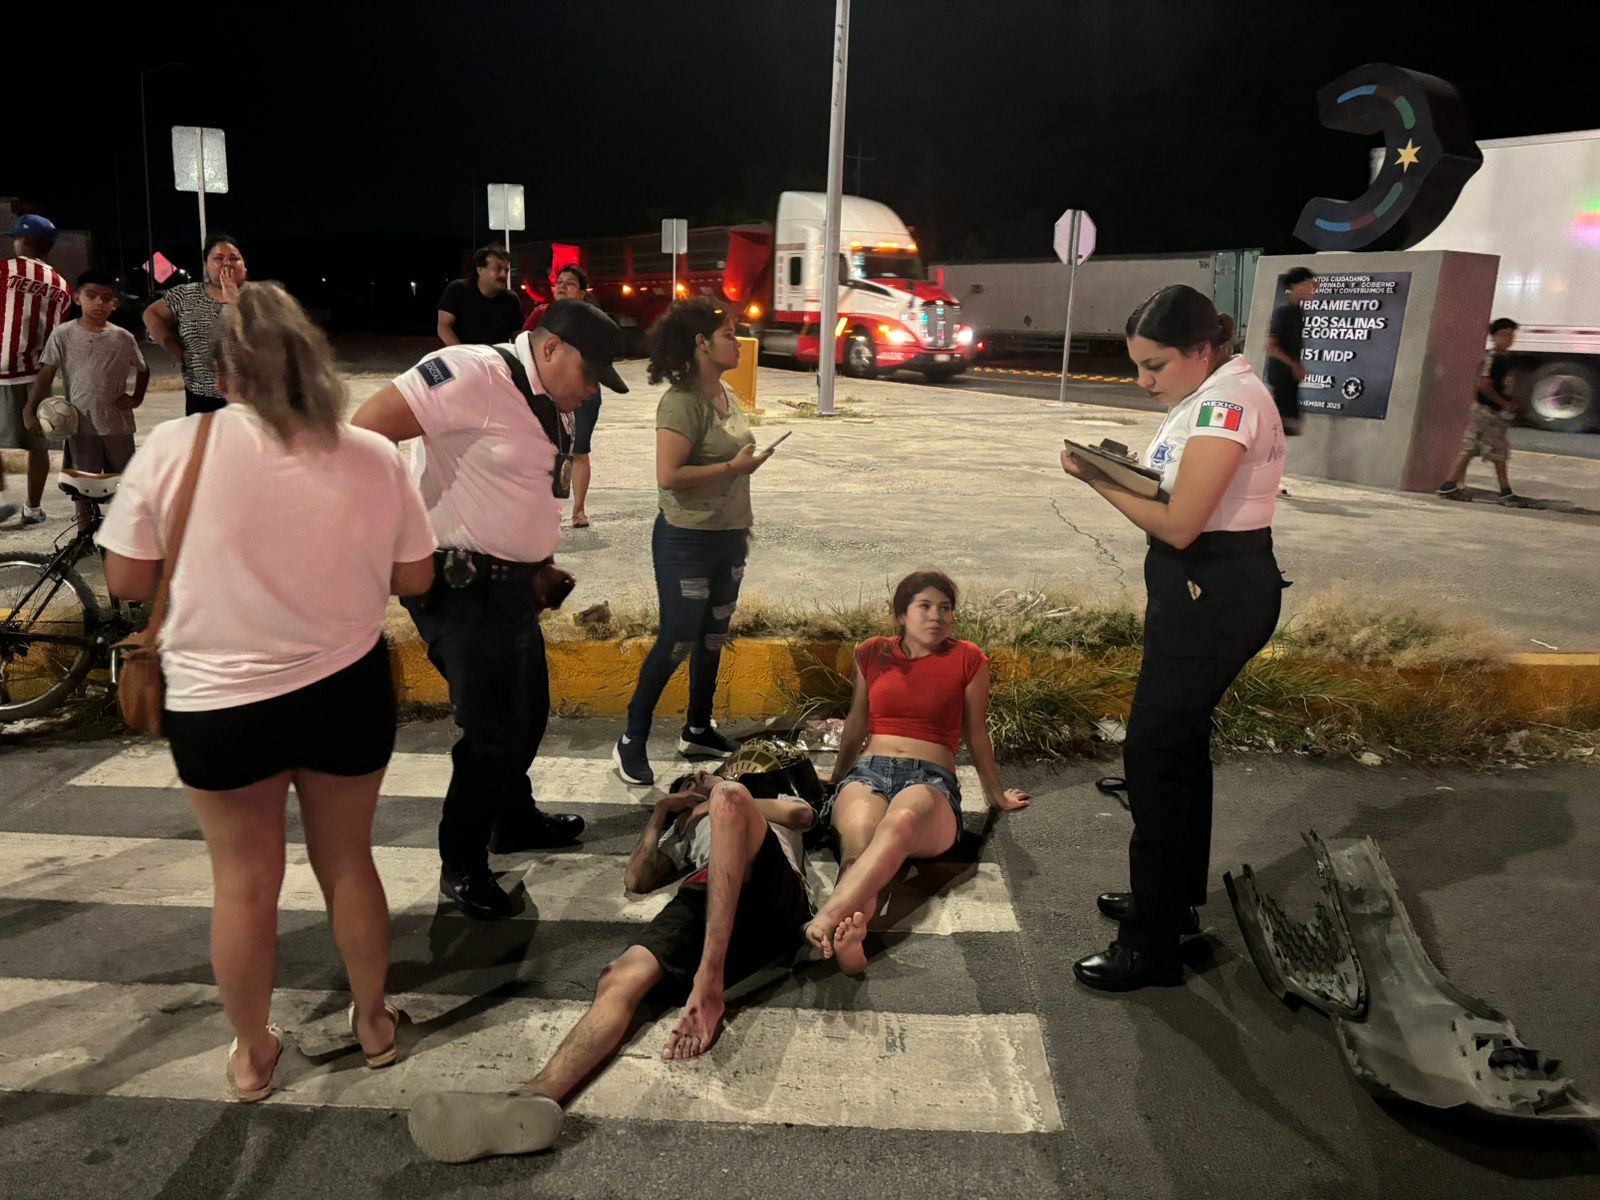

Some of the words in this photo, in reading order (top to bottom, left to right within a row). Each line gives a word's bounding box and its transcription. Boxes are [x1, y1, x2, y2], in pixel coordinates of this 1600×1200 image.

[7, 275, 68, 303] TECATE
[1301, 299, 1379, 311] IBRAMIENTO
[1303, 316, 1329, 328] LOS
[1329, 317, 1386, 329] SALINAS
[1302, 328, 1310, 339] E
[1311, 328, 1368, 340] GORTARI
[1322, 349, 1354, 362] MDP
[1304, 374, 1332, 384] HUILA
[1298, 399, 1325, 408] VIEMBRE
